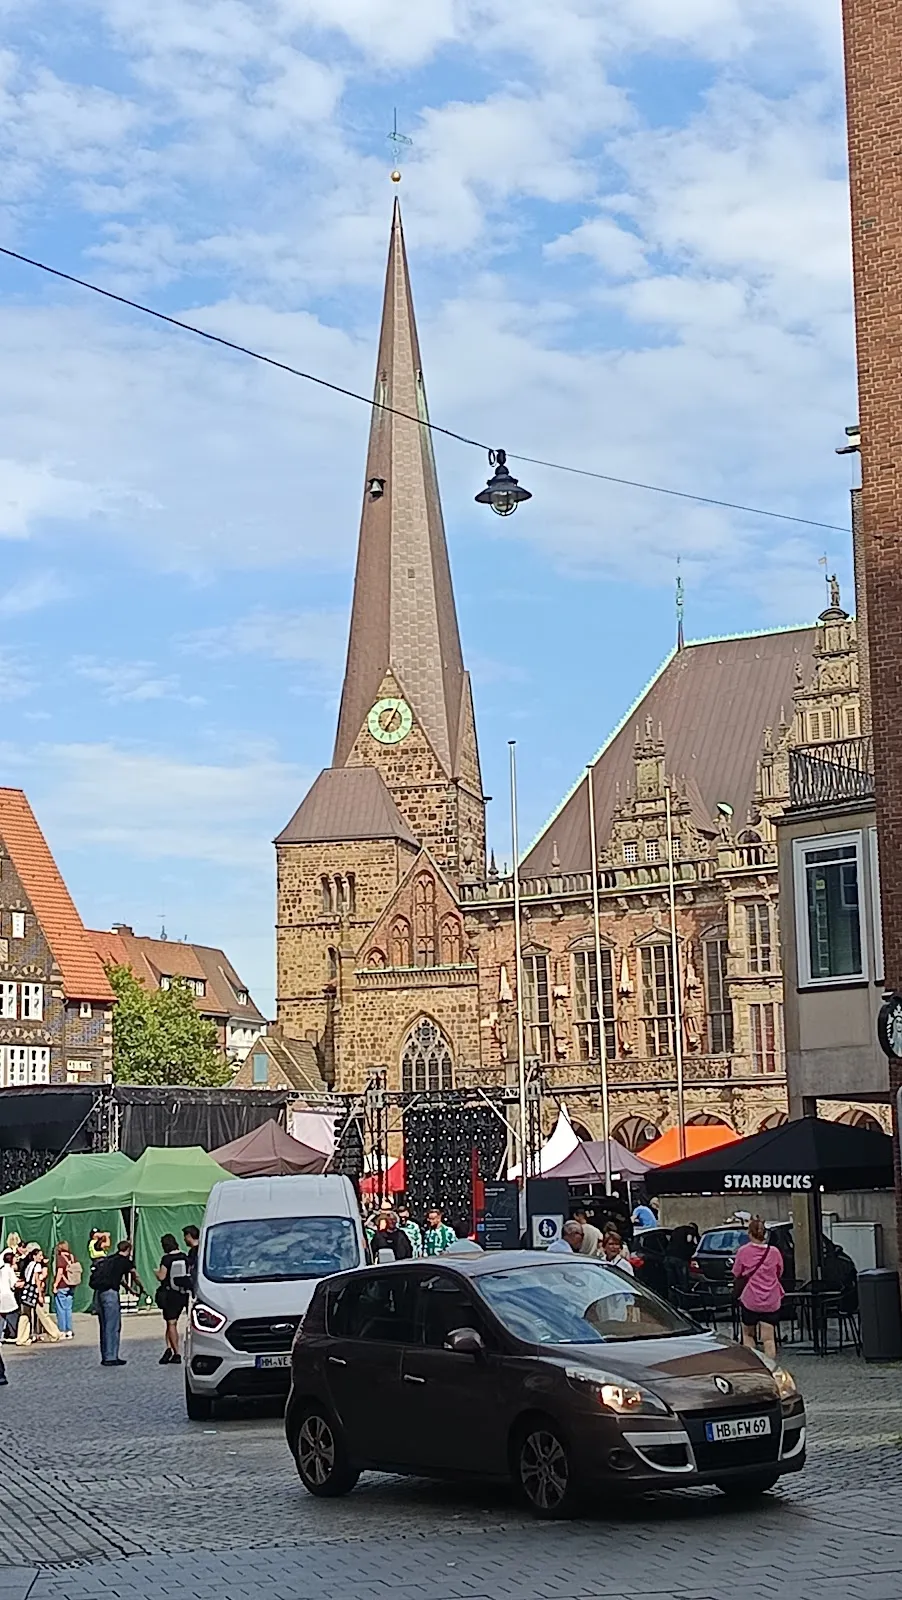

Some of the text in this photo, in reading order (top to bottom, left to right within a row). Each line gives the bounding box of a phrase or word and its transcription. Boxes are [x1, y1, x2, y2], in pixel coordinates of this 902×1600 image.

[724, 1174, 812, 1189] STARBUCKS
[716, 1419, 766, 1438] HB FW 69
